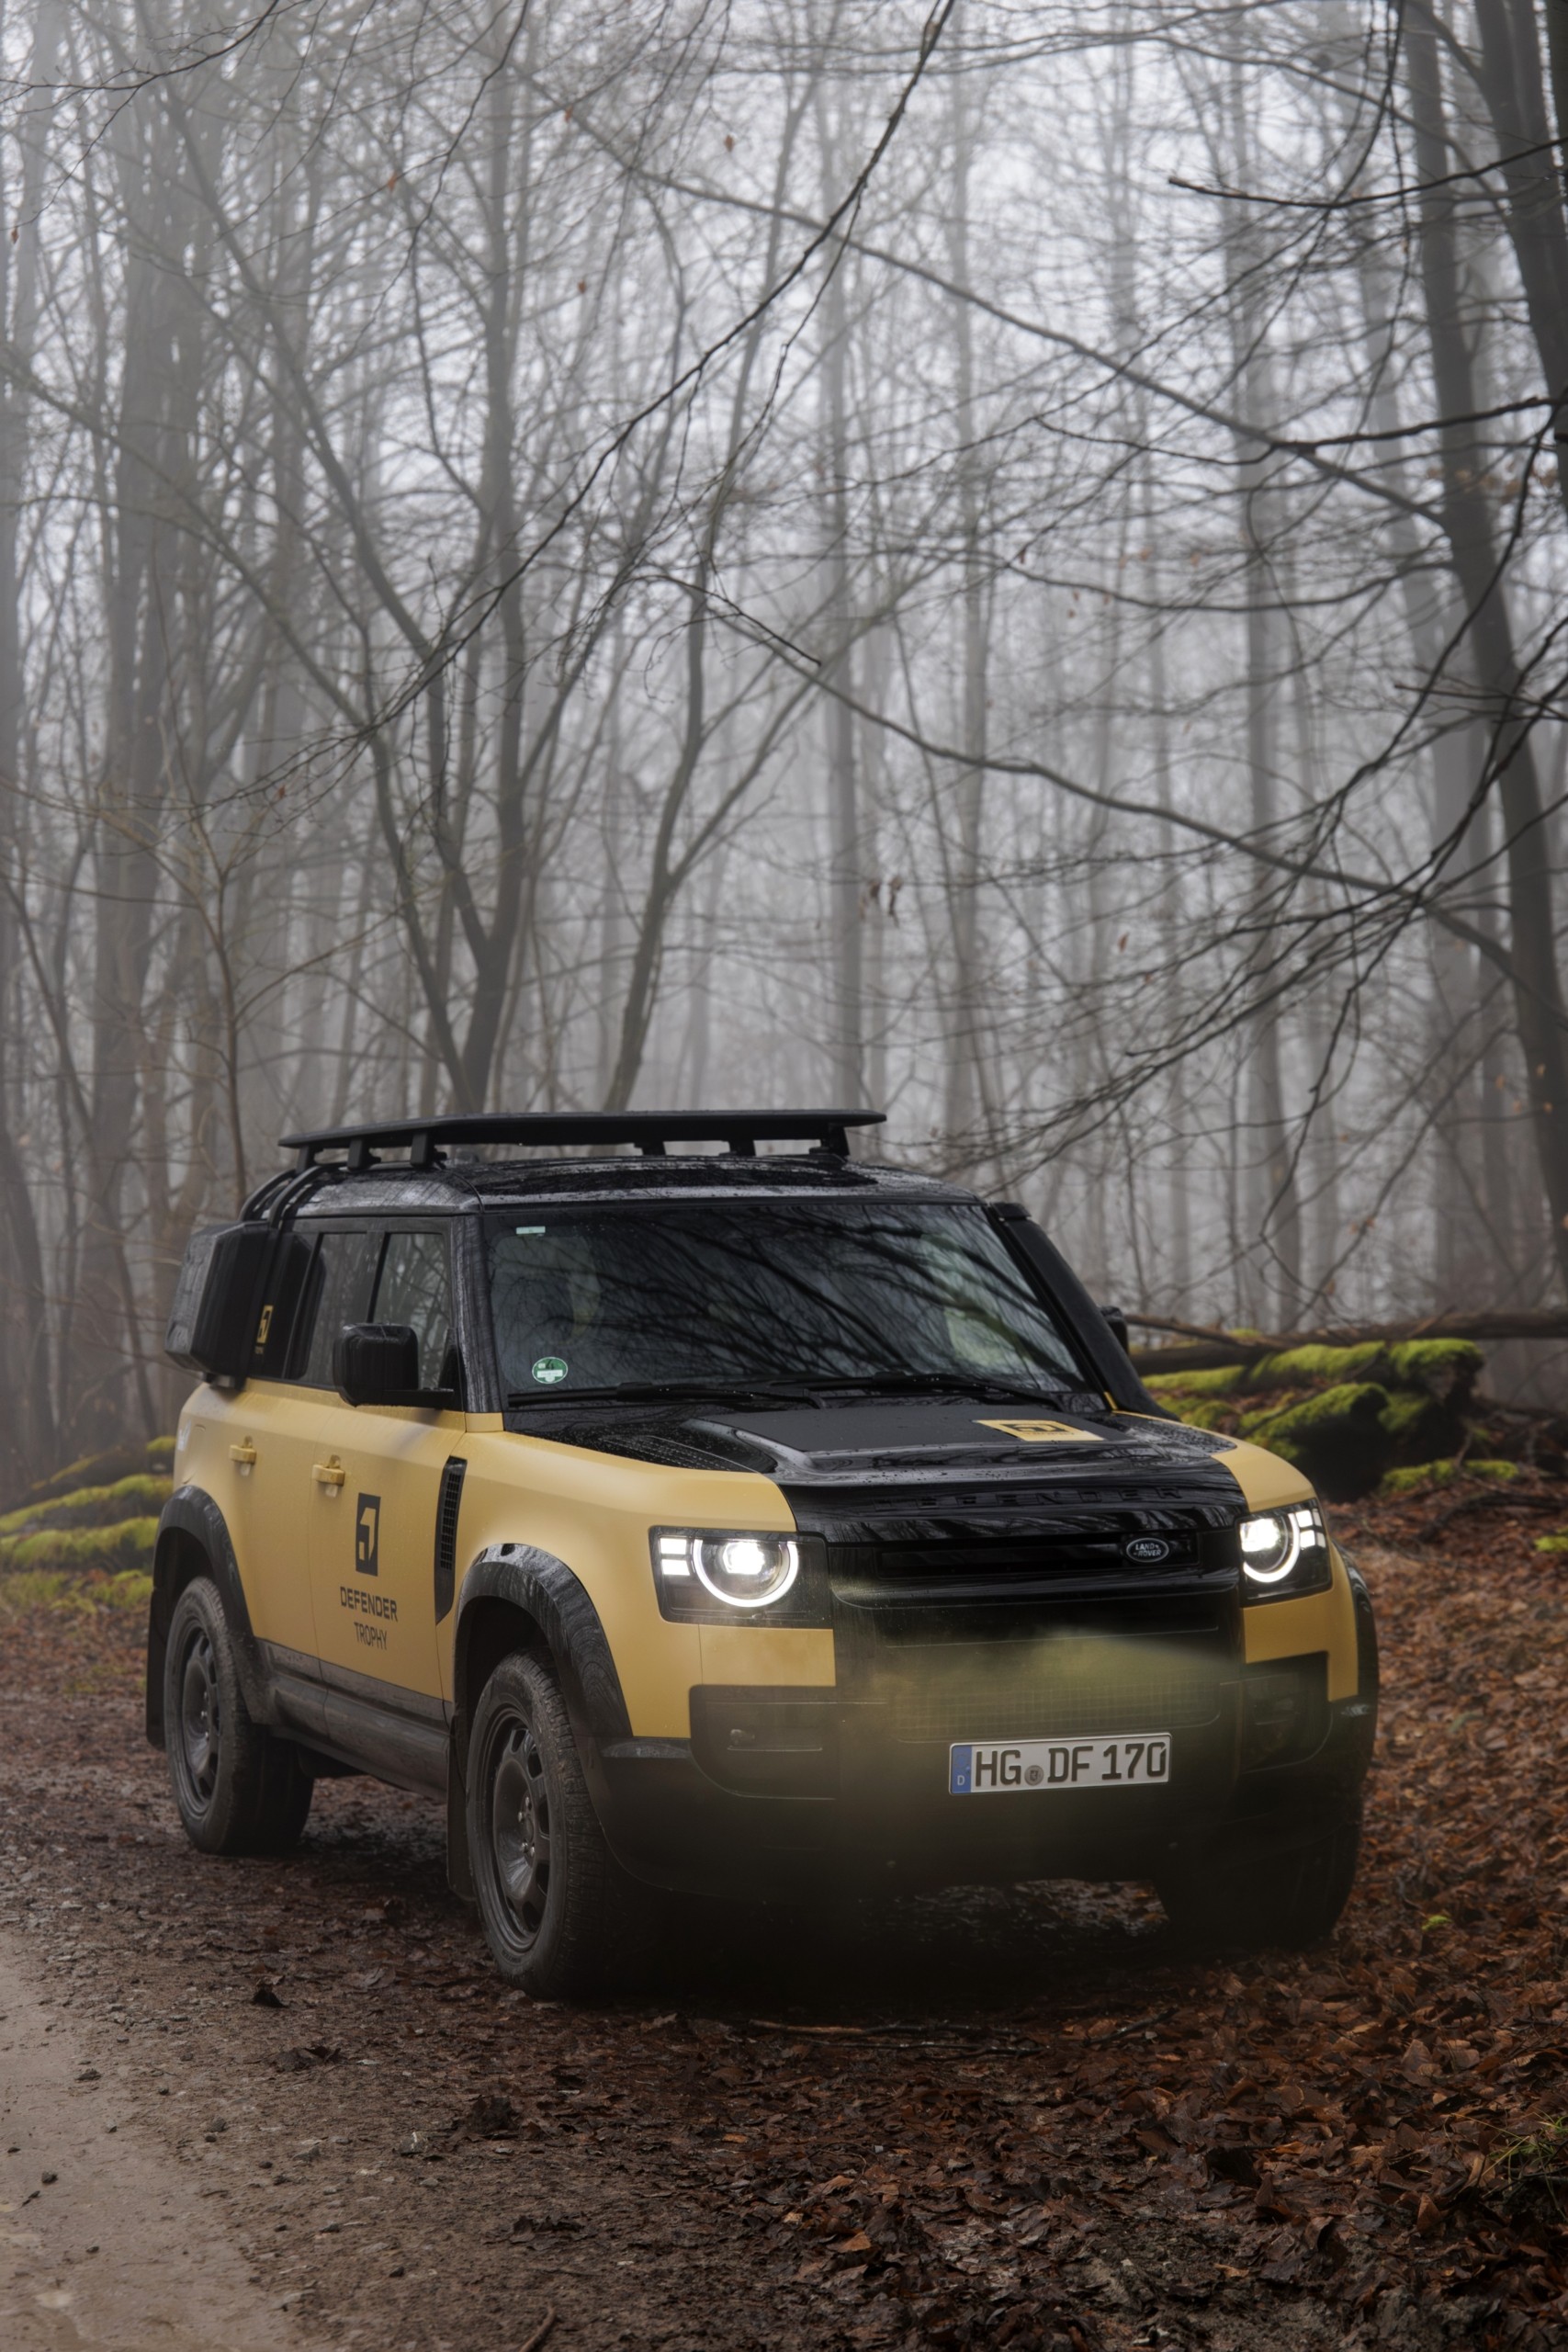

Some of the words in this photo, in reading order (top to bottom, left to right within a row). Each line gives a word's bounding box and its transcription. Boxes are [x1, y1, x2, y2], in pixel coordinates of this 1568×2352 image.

[874, 1487, 1181, 1512] DEFENDER
[340, 1586, 398, 1622] DEFENDER
[354, 1622, 387, 1650] TROPHY
[976, 1749, 1021, 1787] HG
[1047, 1746, 1093, 1783] DF
[1102, 1742, 1167, 1780] 170
[957, 1775, 965, 1786] D
